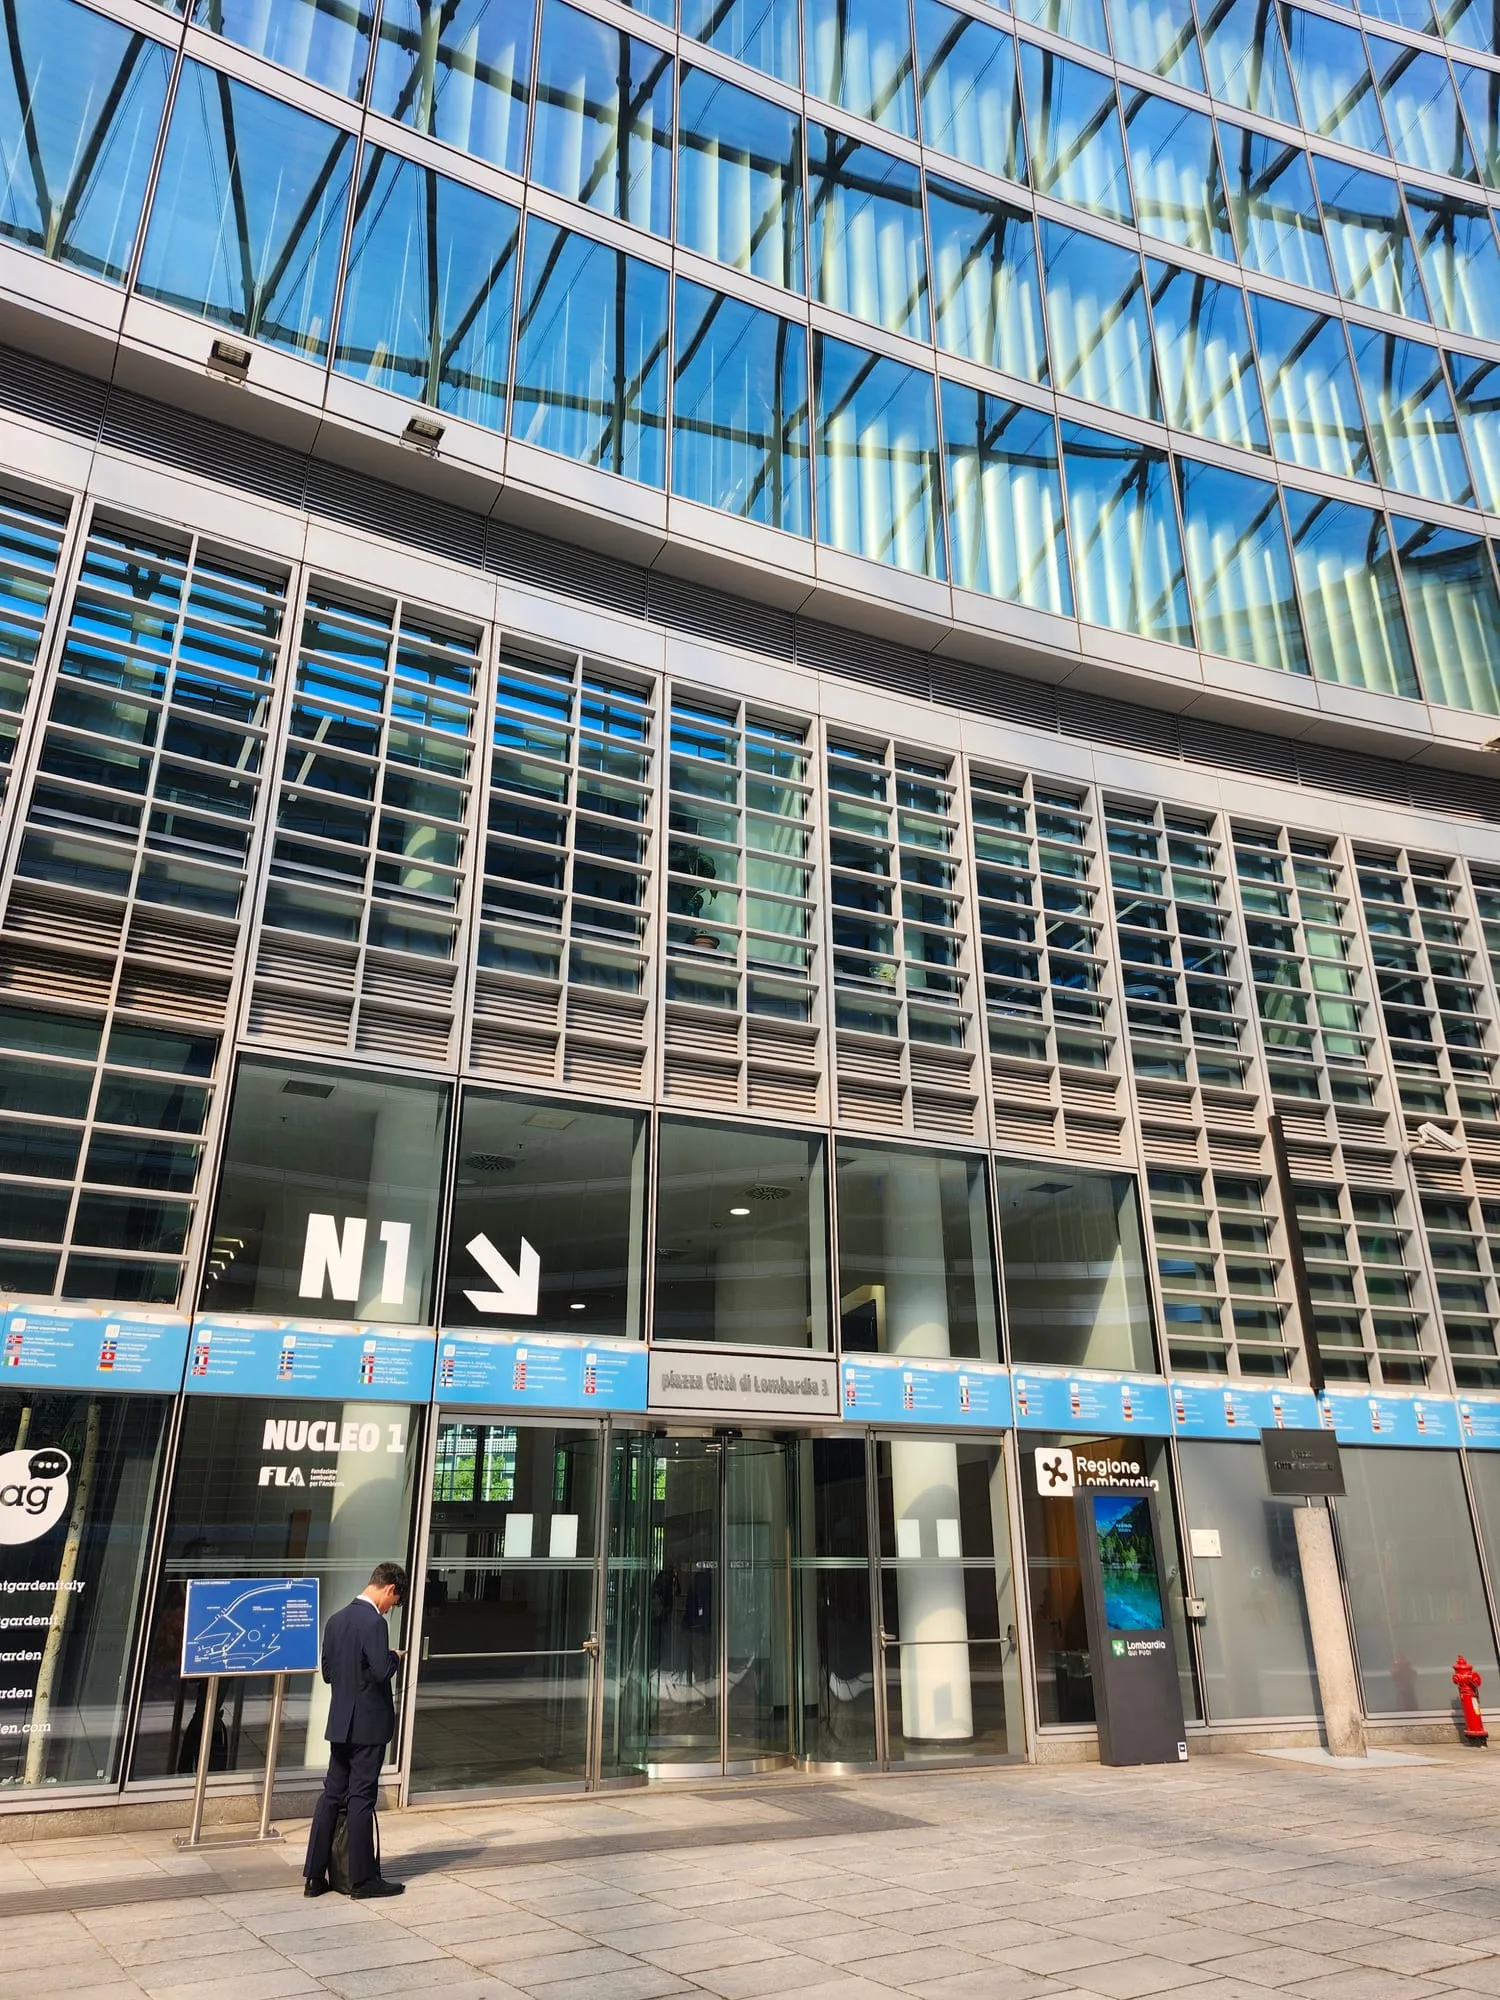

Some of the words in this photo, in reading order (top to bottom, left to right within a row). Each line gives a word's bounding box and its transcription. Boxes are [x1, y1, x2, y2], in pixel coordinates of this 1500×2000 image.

[661, 1370, 703, 1392] piazza
[740, 1374, 752, 1392] di
[754, 1376, 819, 1396] Lombardia
[262, 1419, 380, 1453] NUCLEO
[386, 1423, 405, 1453] 1
[1076, 1456, 1140, 1477] Regione
[257, 1466, 306, 1487] FLA
[0, 1484, 54, 1515] ag
[0, 1580, 86, 1594] tgardenitaly
[0, 1614, 59, 1629] gardenit
[1126, 1640, 1165, 1649] Lombardia
[0, 1650, 42, 1661] arden
[0, 1722, 51, 1734] en.com
